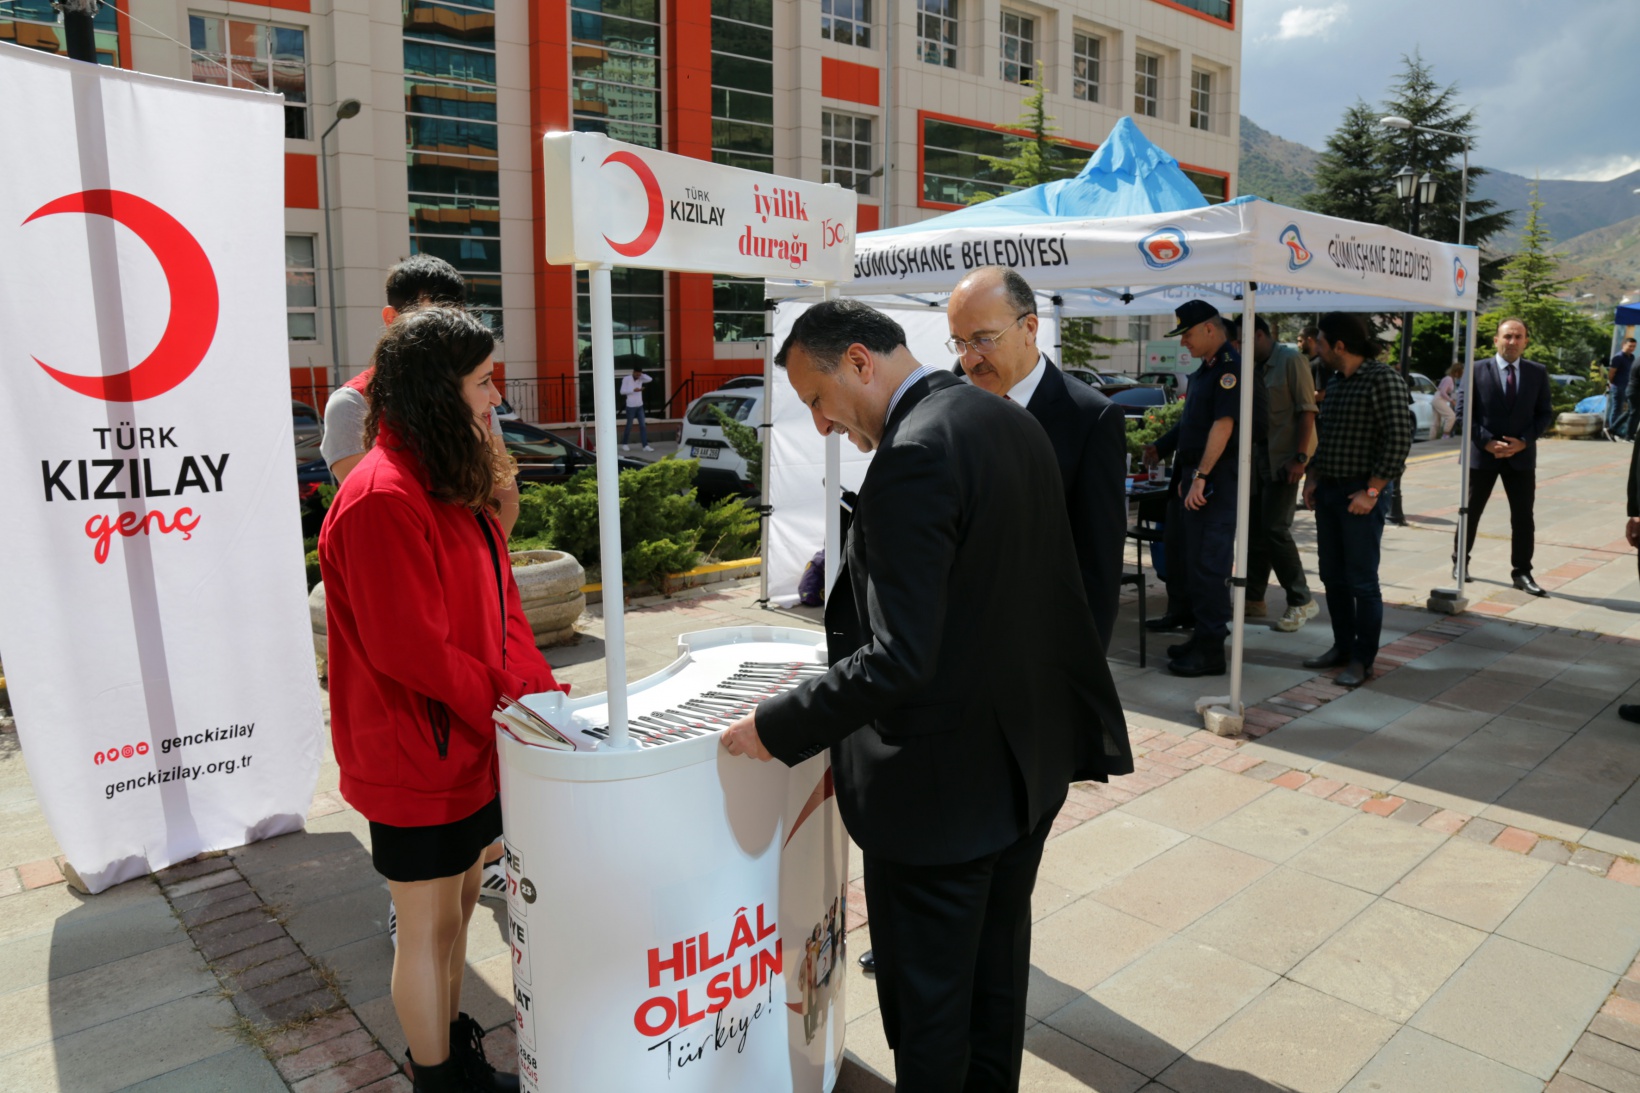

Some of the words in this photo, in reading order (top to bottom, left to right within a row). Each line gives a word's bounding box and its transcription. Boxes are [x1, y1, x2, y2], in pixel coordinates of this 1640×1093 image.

[670, 200, 725, 226] KIZILAY
[685, 186, 710, 202] TÜRK
[753, 184, 809, 224] iyilik
[738, 224, 808, 269] durağı
[821, 217, 846, 250] 150
[962, 233, 1069, 270] BELEDİYESİ
[1328, 234, 1386, 279] GÜMÜŞHANE
[1389, 246, 1432, 282] BELEDİYESİ
[93, 421, 179, 450] TÜRK
[41, 453, 230, 502] KIZILAY
[85, 506, 201, 564] genç
[161, 722, 255, 753] genckizilay
[105, 754, 253, 799] genckizilay.org.tr
[634, 937, 782, 1037] OLSUN
[648, 969, 774, 1080] Türkiye!
